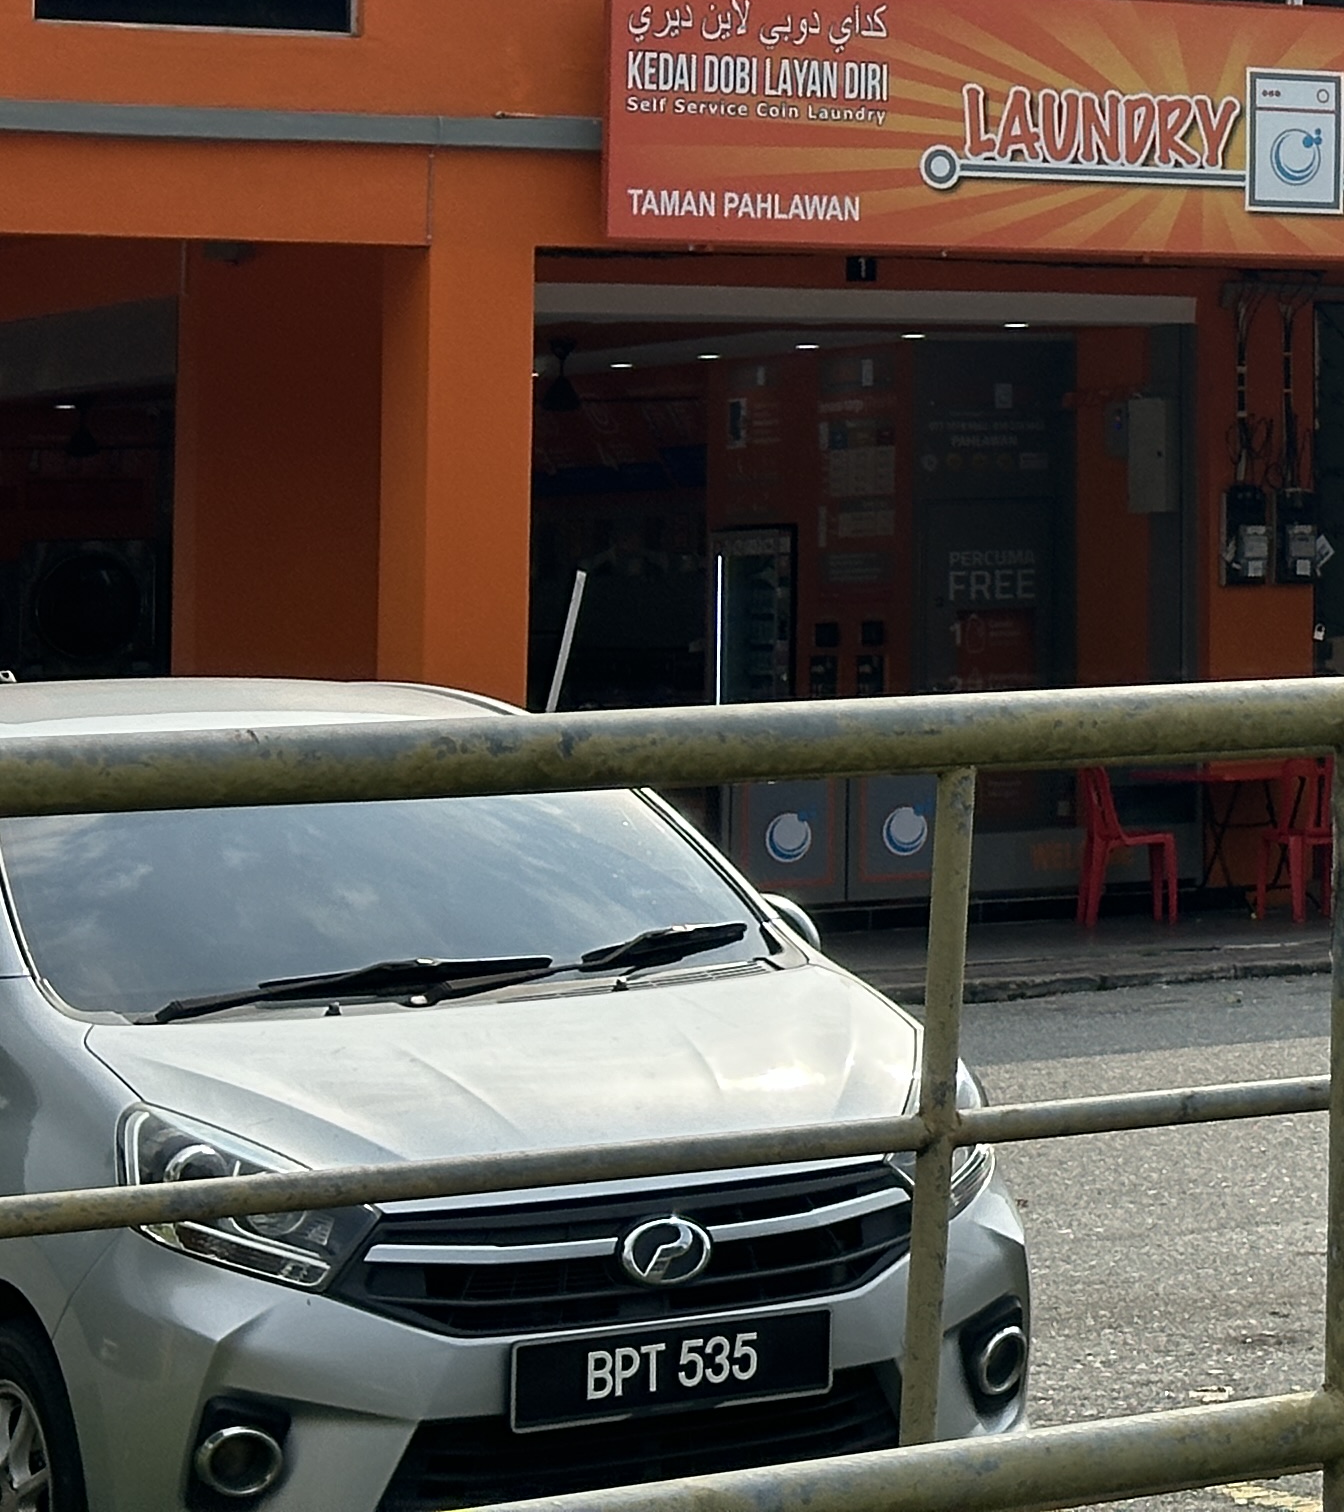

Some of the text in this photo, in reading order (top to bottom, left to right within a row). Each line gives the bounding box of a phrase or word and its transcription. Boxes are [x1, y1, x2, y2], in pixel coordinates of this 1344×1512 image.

[628, 4, 693, 42] ديري
[760, 11, 820, 49] دوبي
[627, 50, 888, 101] KEDAI DOBI LAYAN DIRI
[627, 96, 886, 125] Self Service Coin Laundry
[962, 83, 1240, 170] LAUNDRY
[628, 189, 861, 222] TAMAN PAHLAWAN
[948, 549, 1036, 568] PERCUMA
[948, 570, 1036, 602] FREE
[587, 1332, 758, 1401] BPT 535
